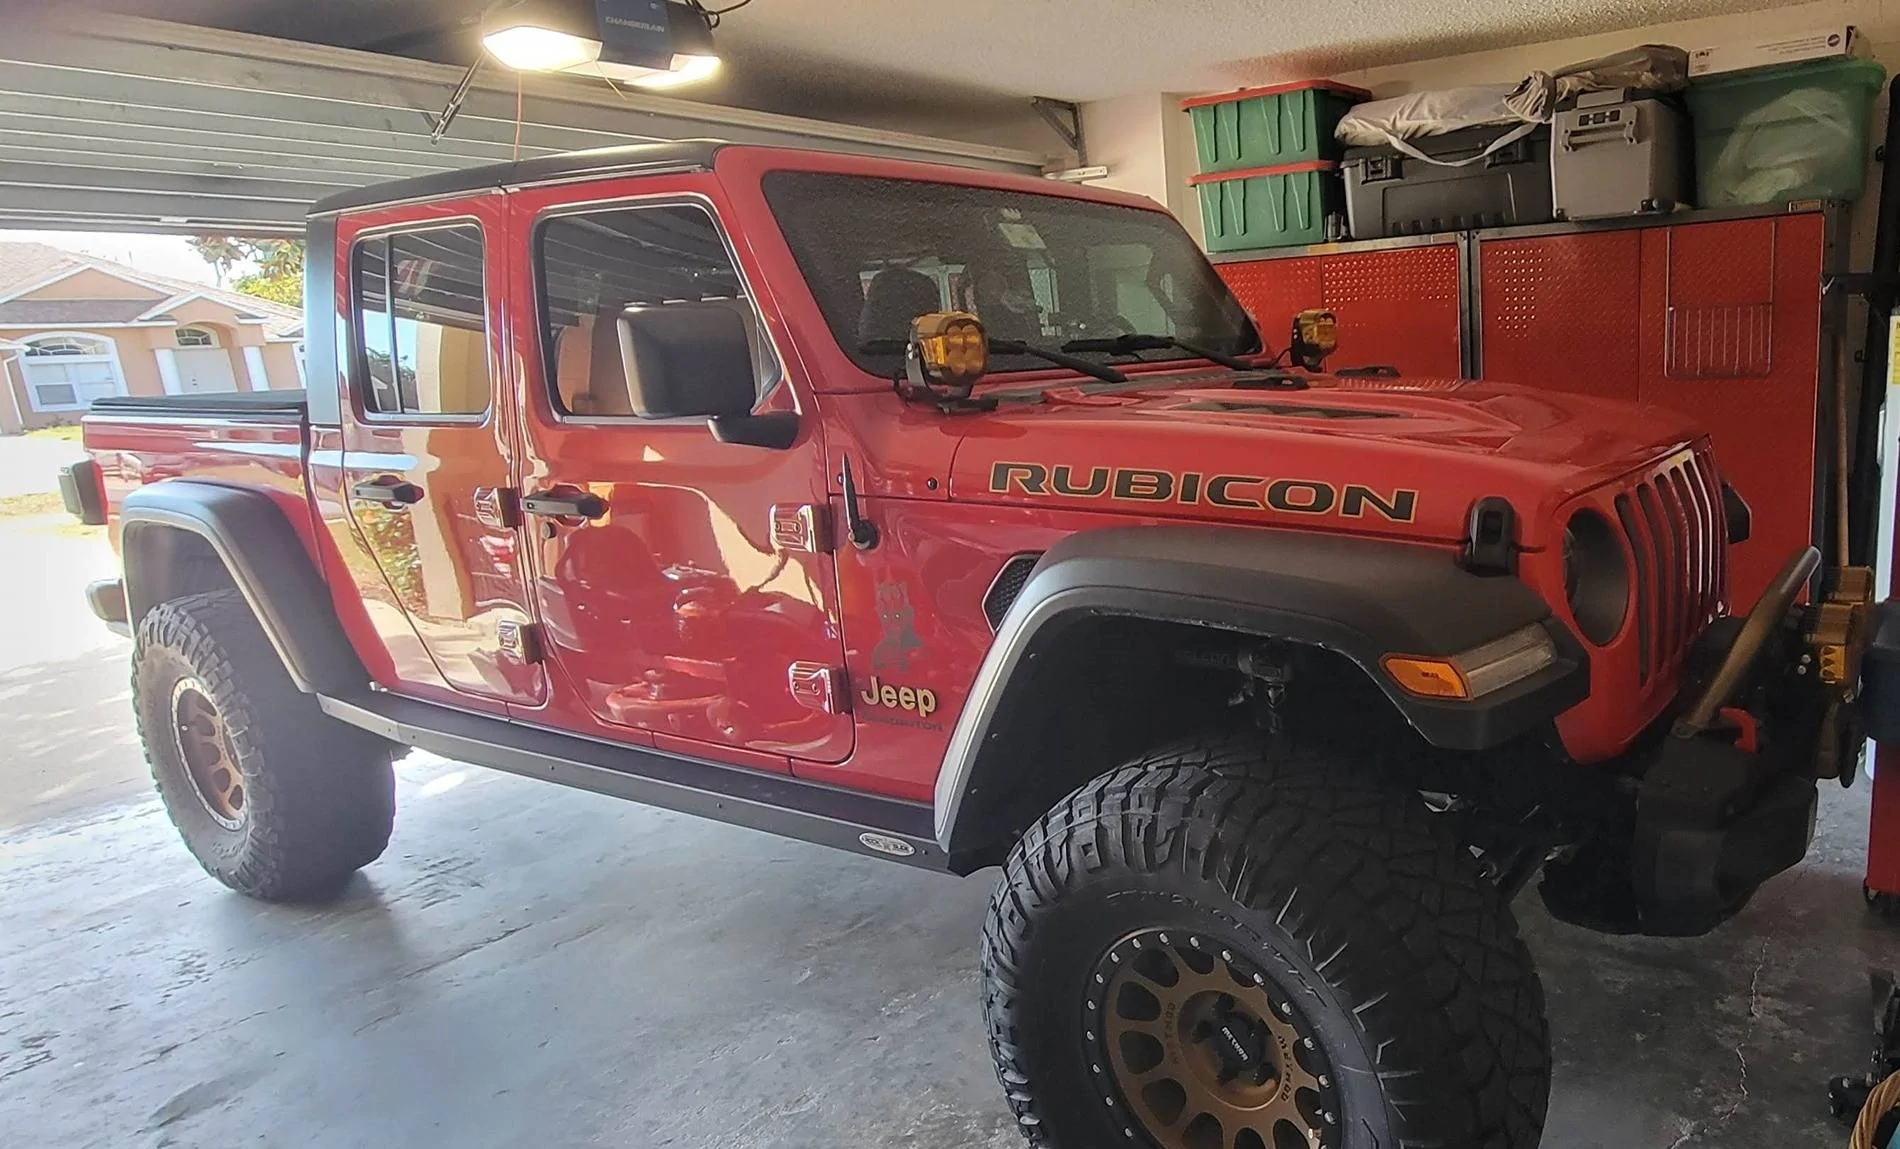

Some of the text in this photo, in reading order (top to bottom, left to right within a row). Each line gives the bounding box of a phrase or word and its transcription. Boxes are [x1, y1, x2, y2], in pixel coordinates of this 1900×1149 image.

[988, 461, 1419, 523] RUBICON
[860, 675, 937, 718] Jeep
[1221, 1026, 1249, 1062] METHOD
[1277, 1035, 1294, 1102] METHOD
